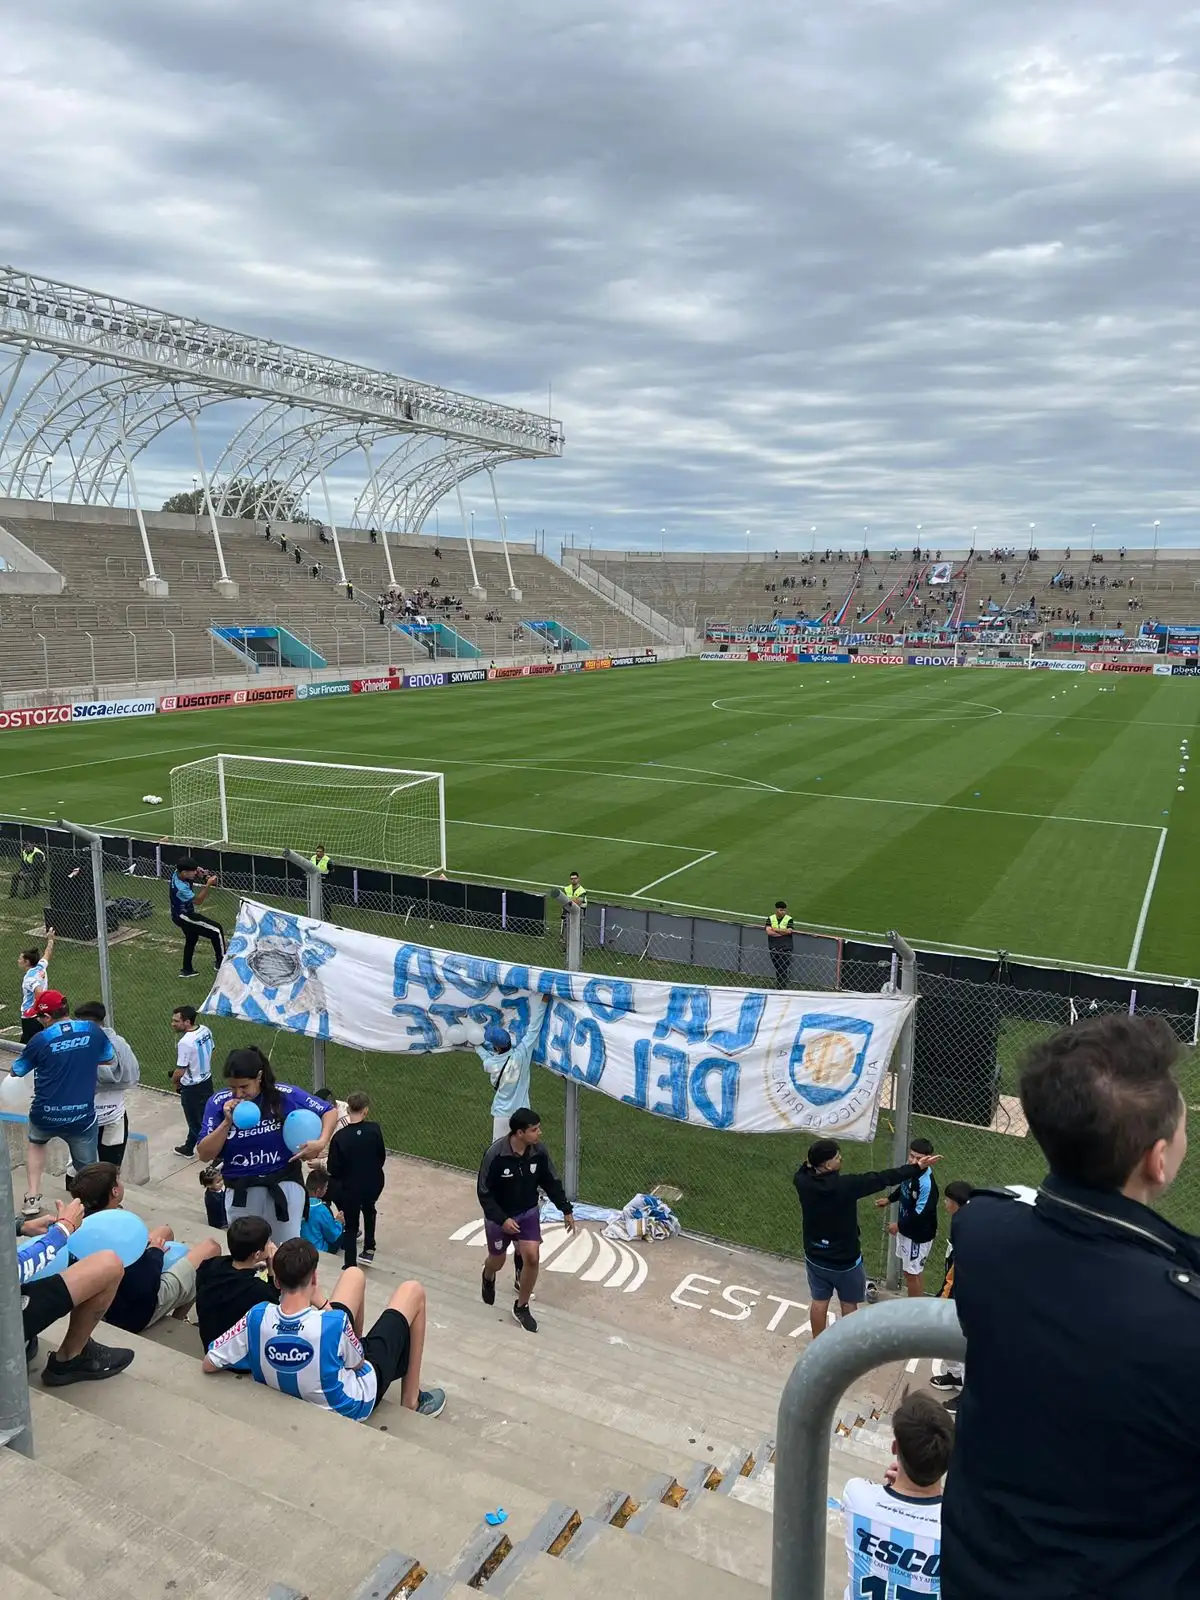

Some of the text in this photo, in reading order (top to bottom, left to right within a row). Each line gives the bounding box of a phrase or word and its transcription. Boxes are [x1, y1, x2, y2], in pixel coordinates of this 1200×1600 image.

[757, 653, 788, 662] Schneider
[409, 673, 444, 687] enova
[452, 671, 485, 682] SKYWORTH
[309, 684, 350, 695] Sur Finanzas
[360, 679, 391, 692] Schneider
[238, 1122, 281, 1138] SEGUROS
[268, 1345, 310, 1361] SanCor
